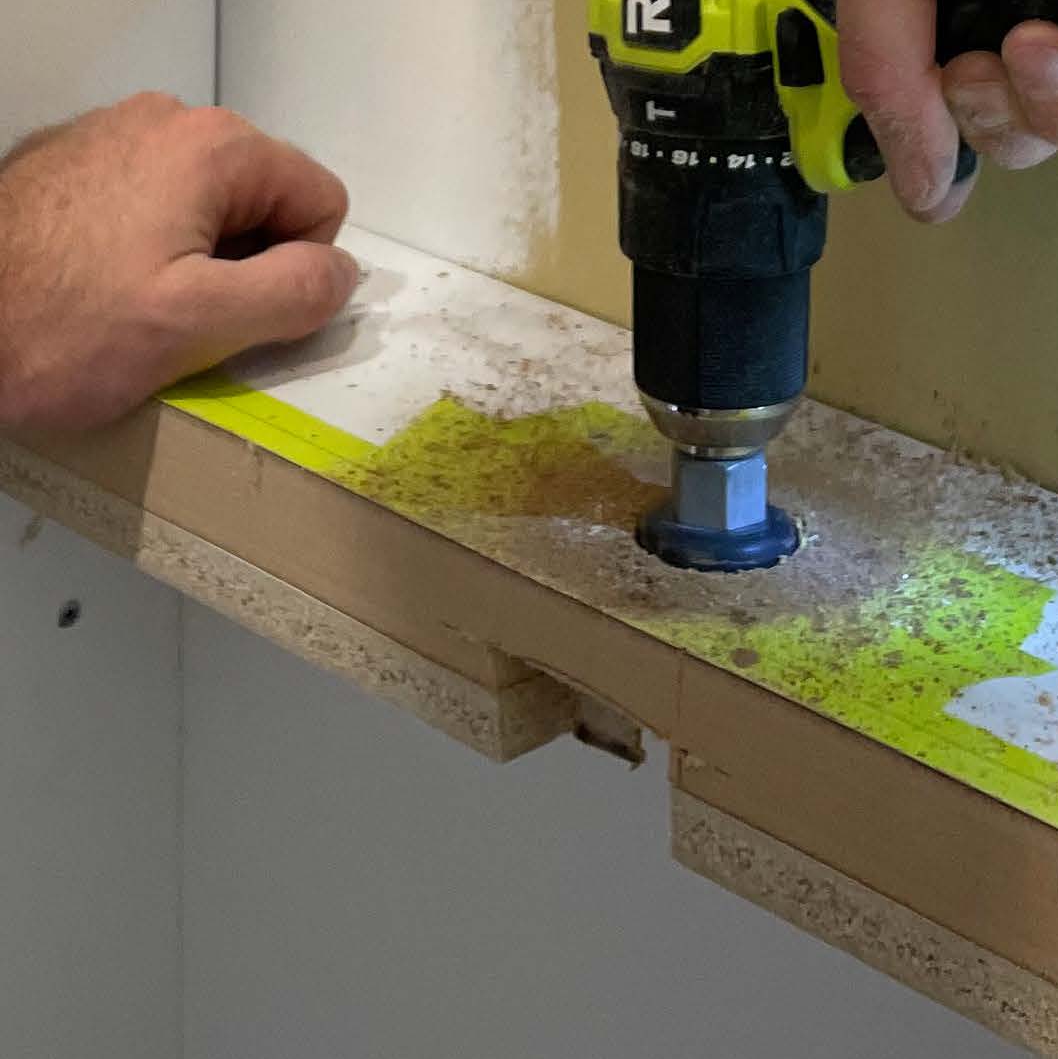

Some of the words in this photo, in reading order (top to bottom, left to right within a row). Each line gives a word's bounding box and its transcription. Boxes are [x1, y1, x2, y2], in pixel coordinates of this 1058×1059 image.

[645, 100, 677, 122] T
[671, 149, 700, 166] 16
[727, 154, 757, 169] 14
